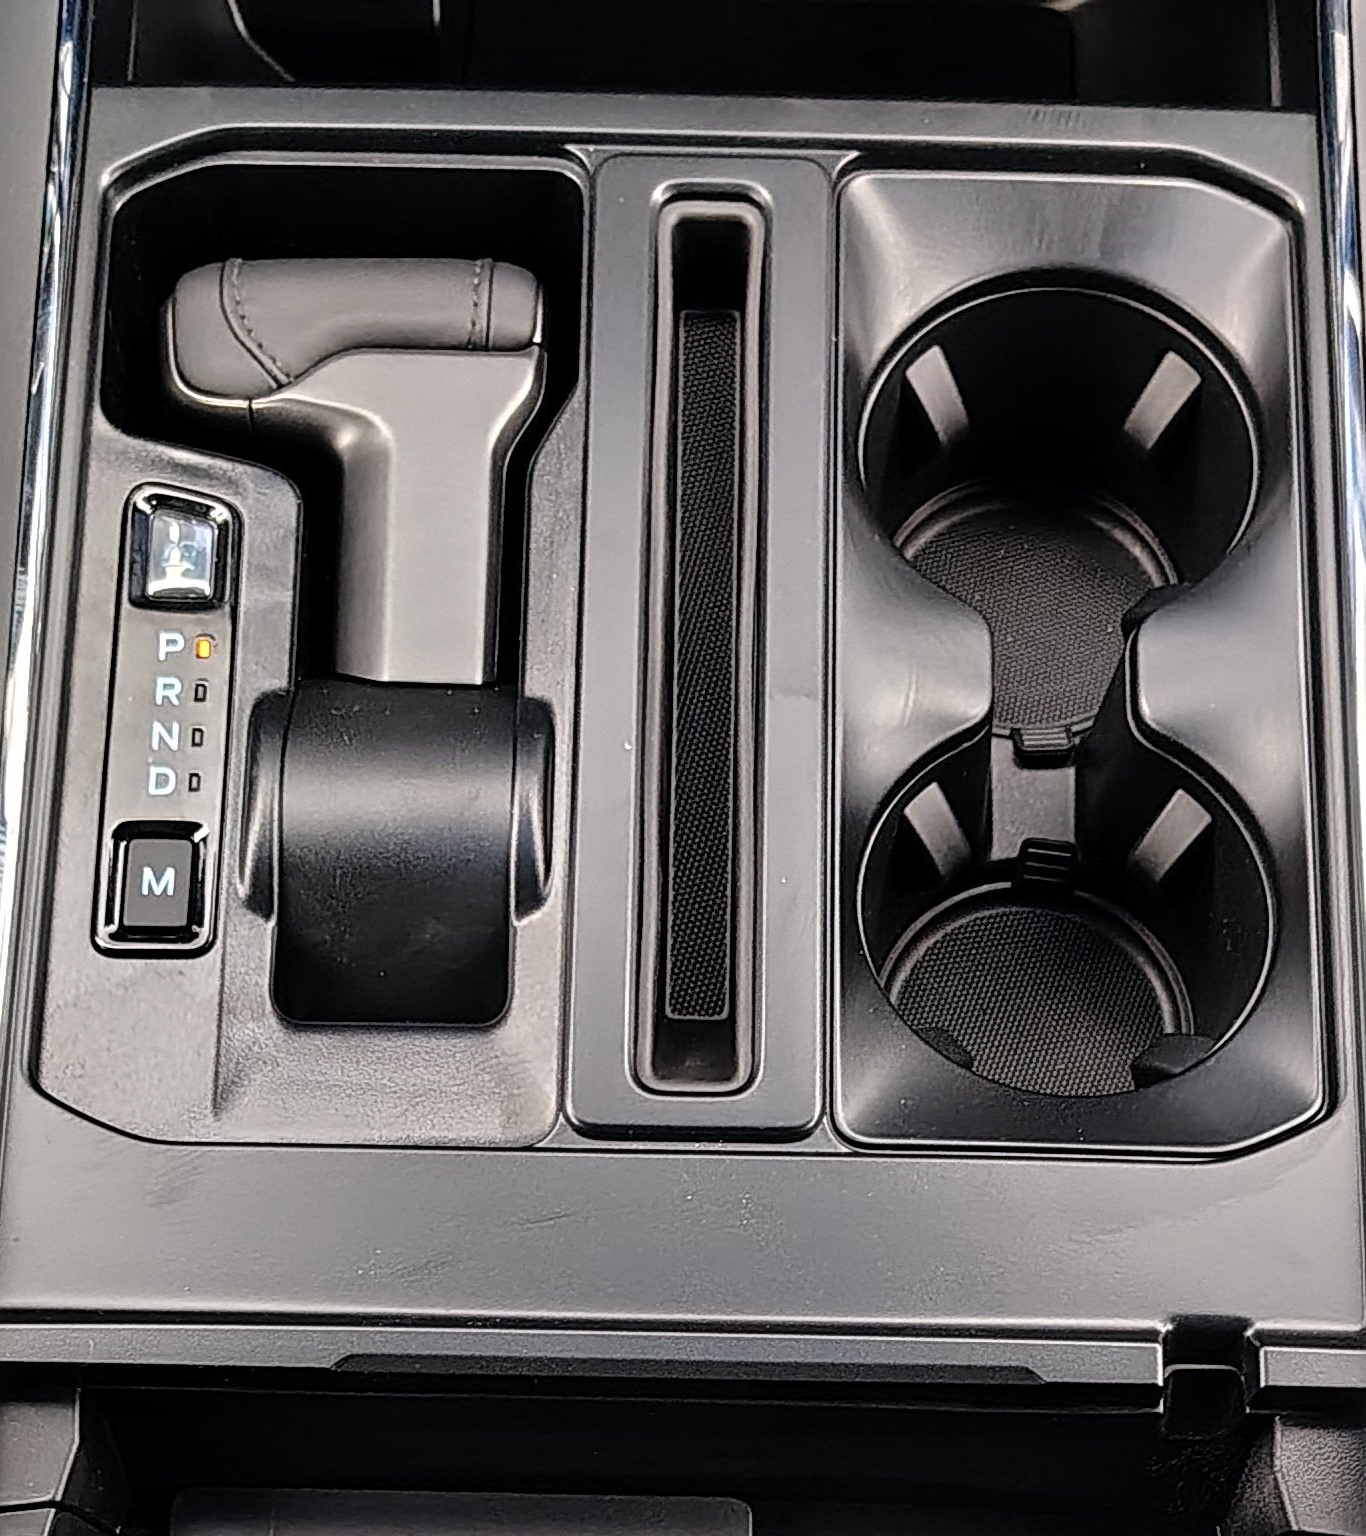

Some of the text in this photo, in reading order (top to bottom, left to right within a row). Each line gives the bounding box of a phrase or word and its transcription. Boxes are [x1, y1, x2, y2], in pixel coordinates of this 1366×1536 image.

[157, 632, 185, 662] P
[155, 675, 182, 708] R
[151, 721, 179, 752] N
[148, 765, 176, 796] D
[141, 866, 176, 896] M
